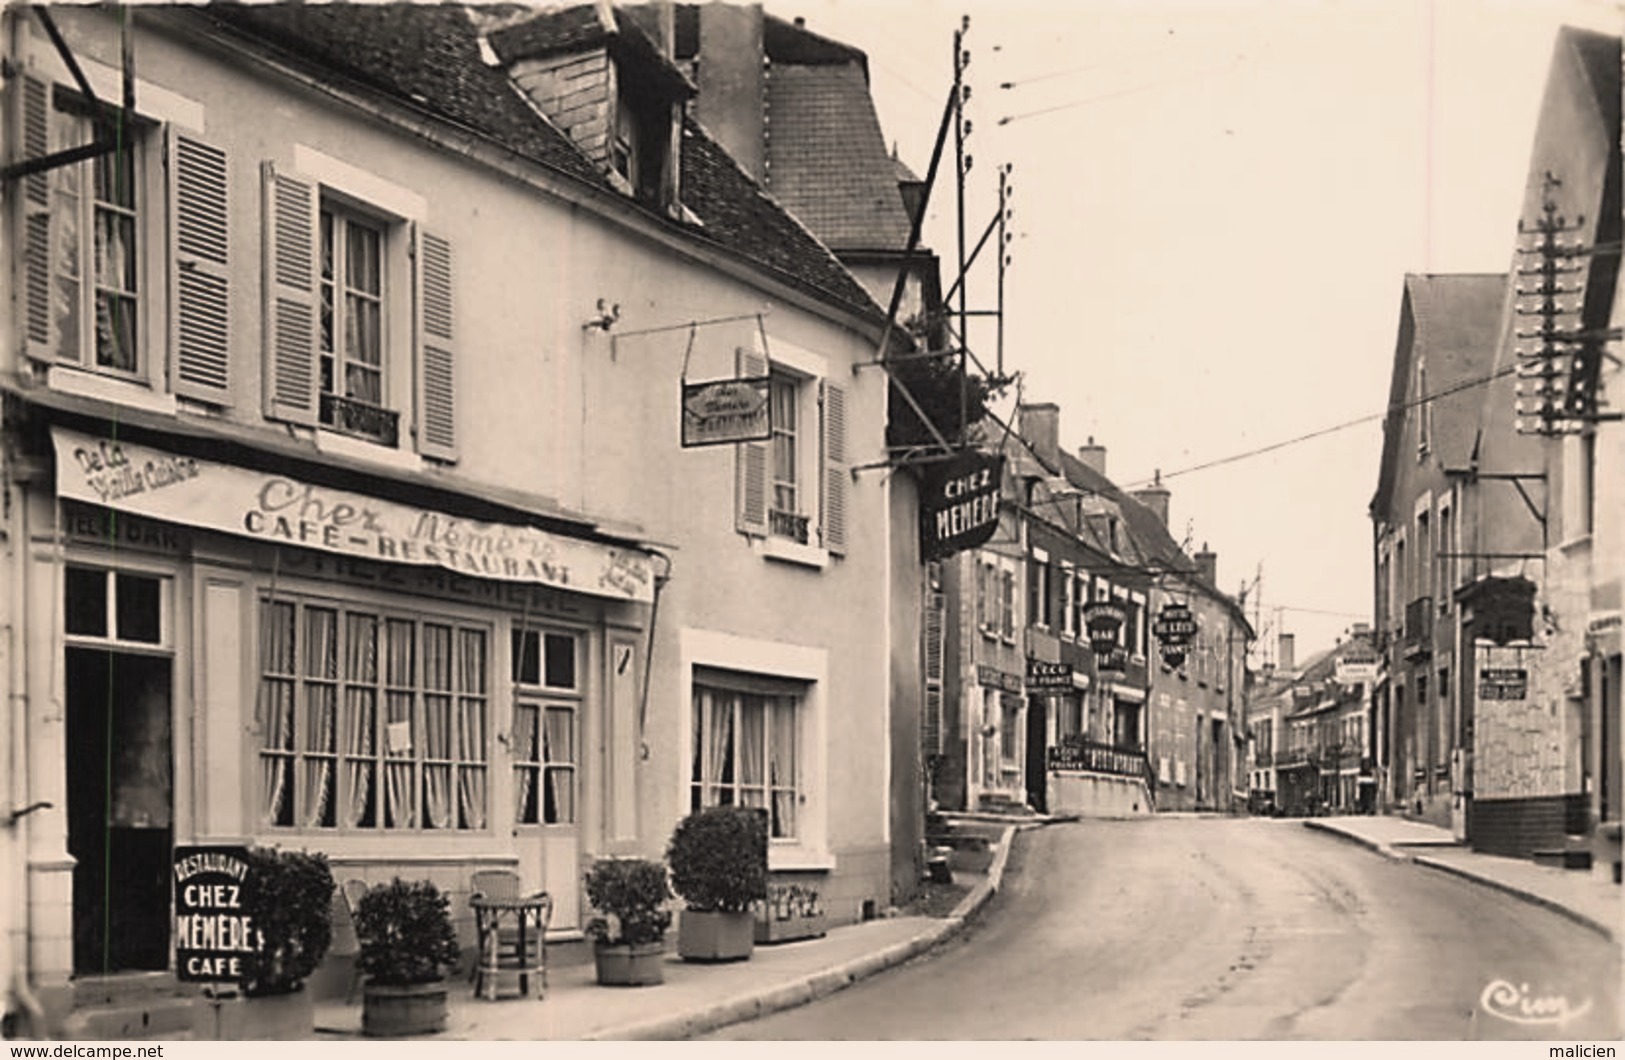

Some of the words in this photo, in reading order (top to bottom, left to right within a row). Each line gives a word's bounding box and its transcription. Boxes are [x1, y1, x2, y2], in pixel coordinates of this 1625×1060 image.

[944, 469, 991, 498] CHEZ
[256, 477, 383, 534] Chez
[1091, 628, 1115, 640] BAR
[174, 853, 249, 884] RESTAURANT
[184, 884, 241, 909] CHEZ
